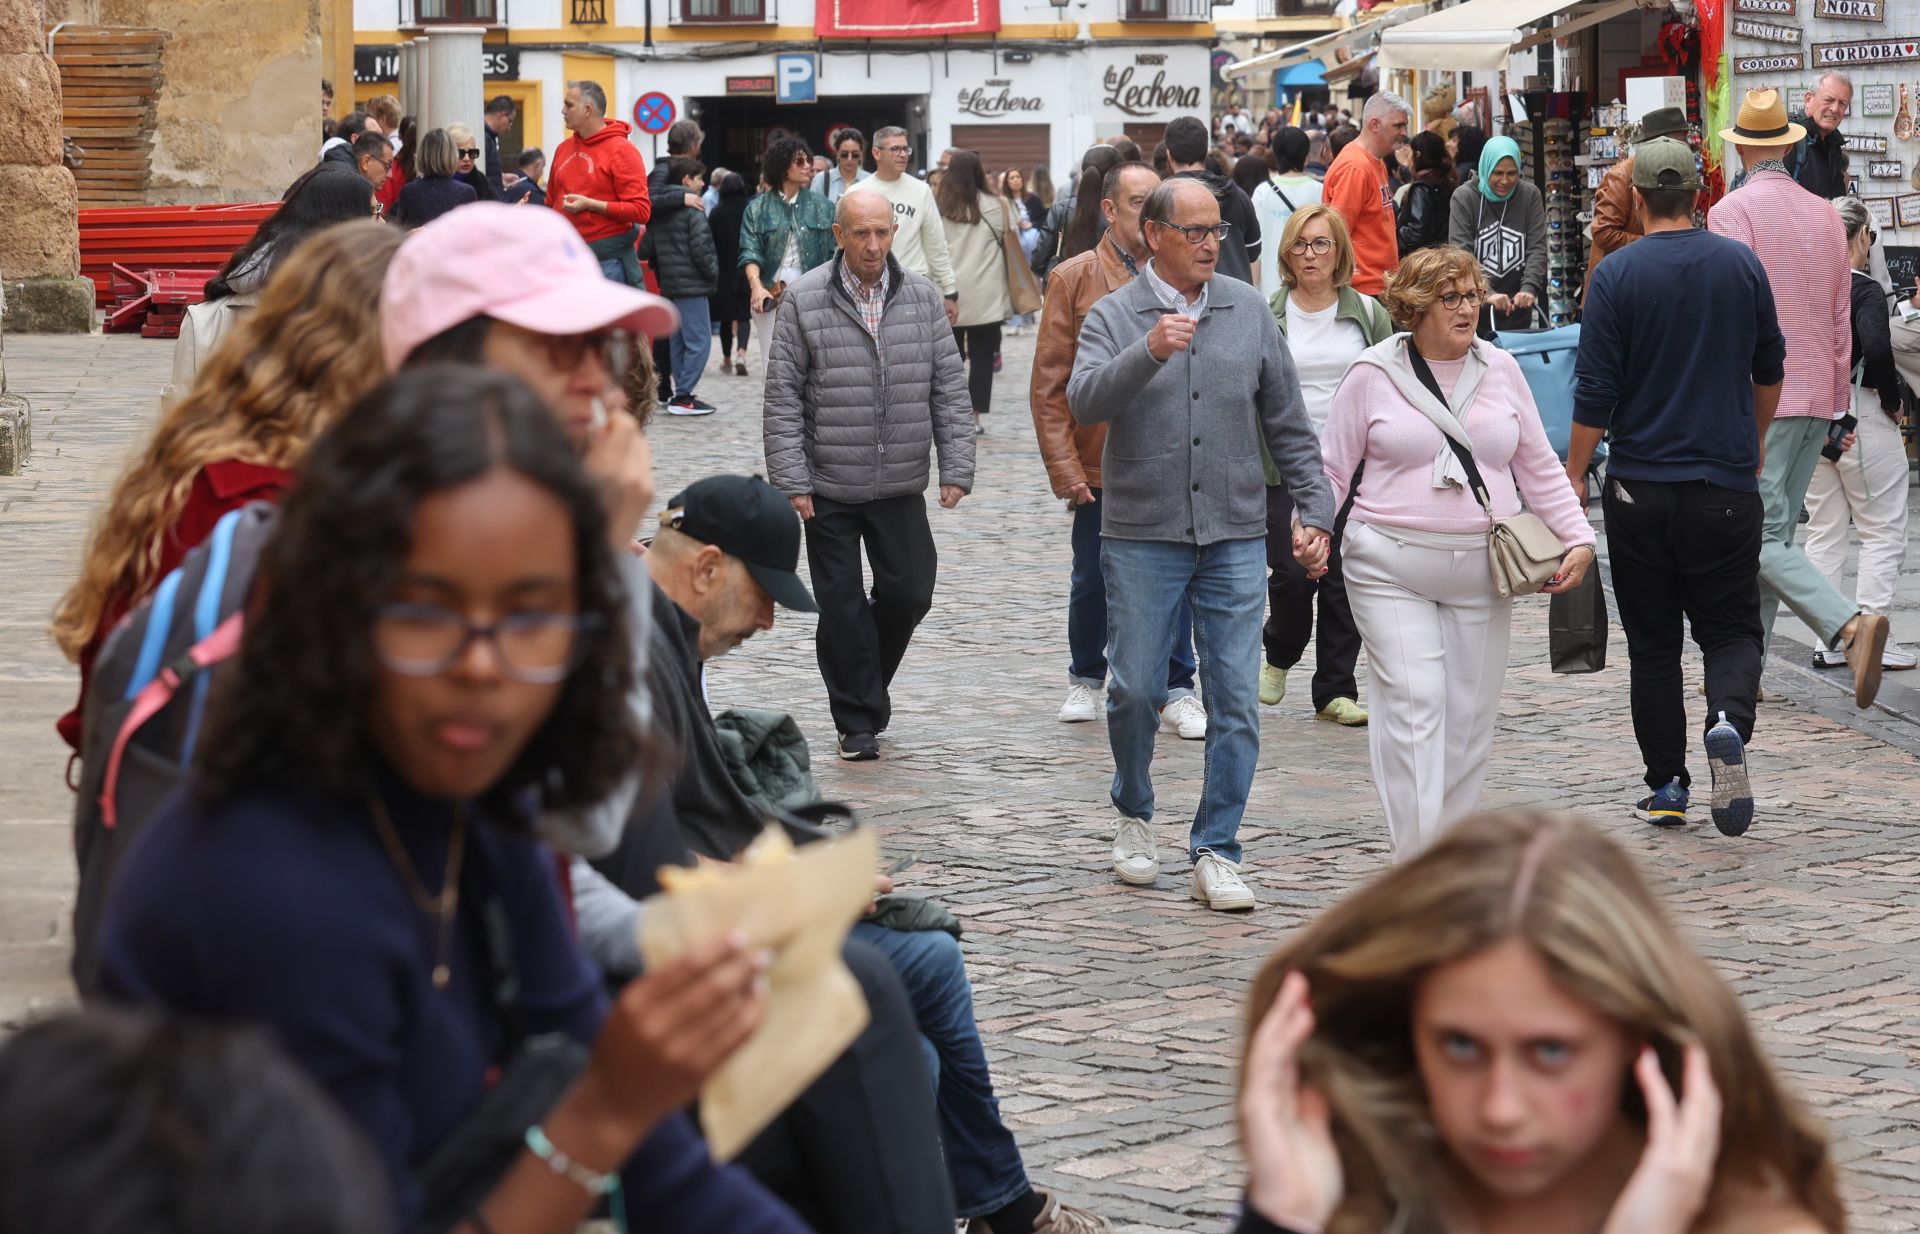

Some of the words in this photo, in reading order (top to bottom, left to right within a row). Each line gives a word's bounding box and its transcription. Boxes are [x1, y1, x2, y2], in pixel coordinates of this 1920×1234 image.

[1742, 0, 1787, 11] ALEXIA
[1827, 0, 1871, 16] NORA
[1742, 23, 1786, 39] MANUEL
[1824, 44, 1903, 61] CORDOBA
[1742, 58, 1795, 70] CORDOBA
[779, 58, 812, 97] P
[1104, 66, 1201, 116] Lechera
[958, 87, 1042, 117] Lechera
[1871, 165, 1892, 174] PAZ
